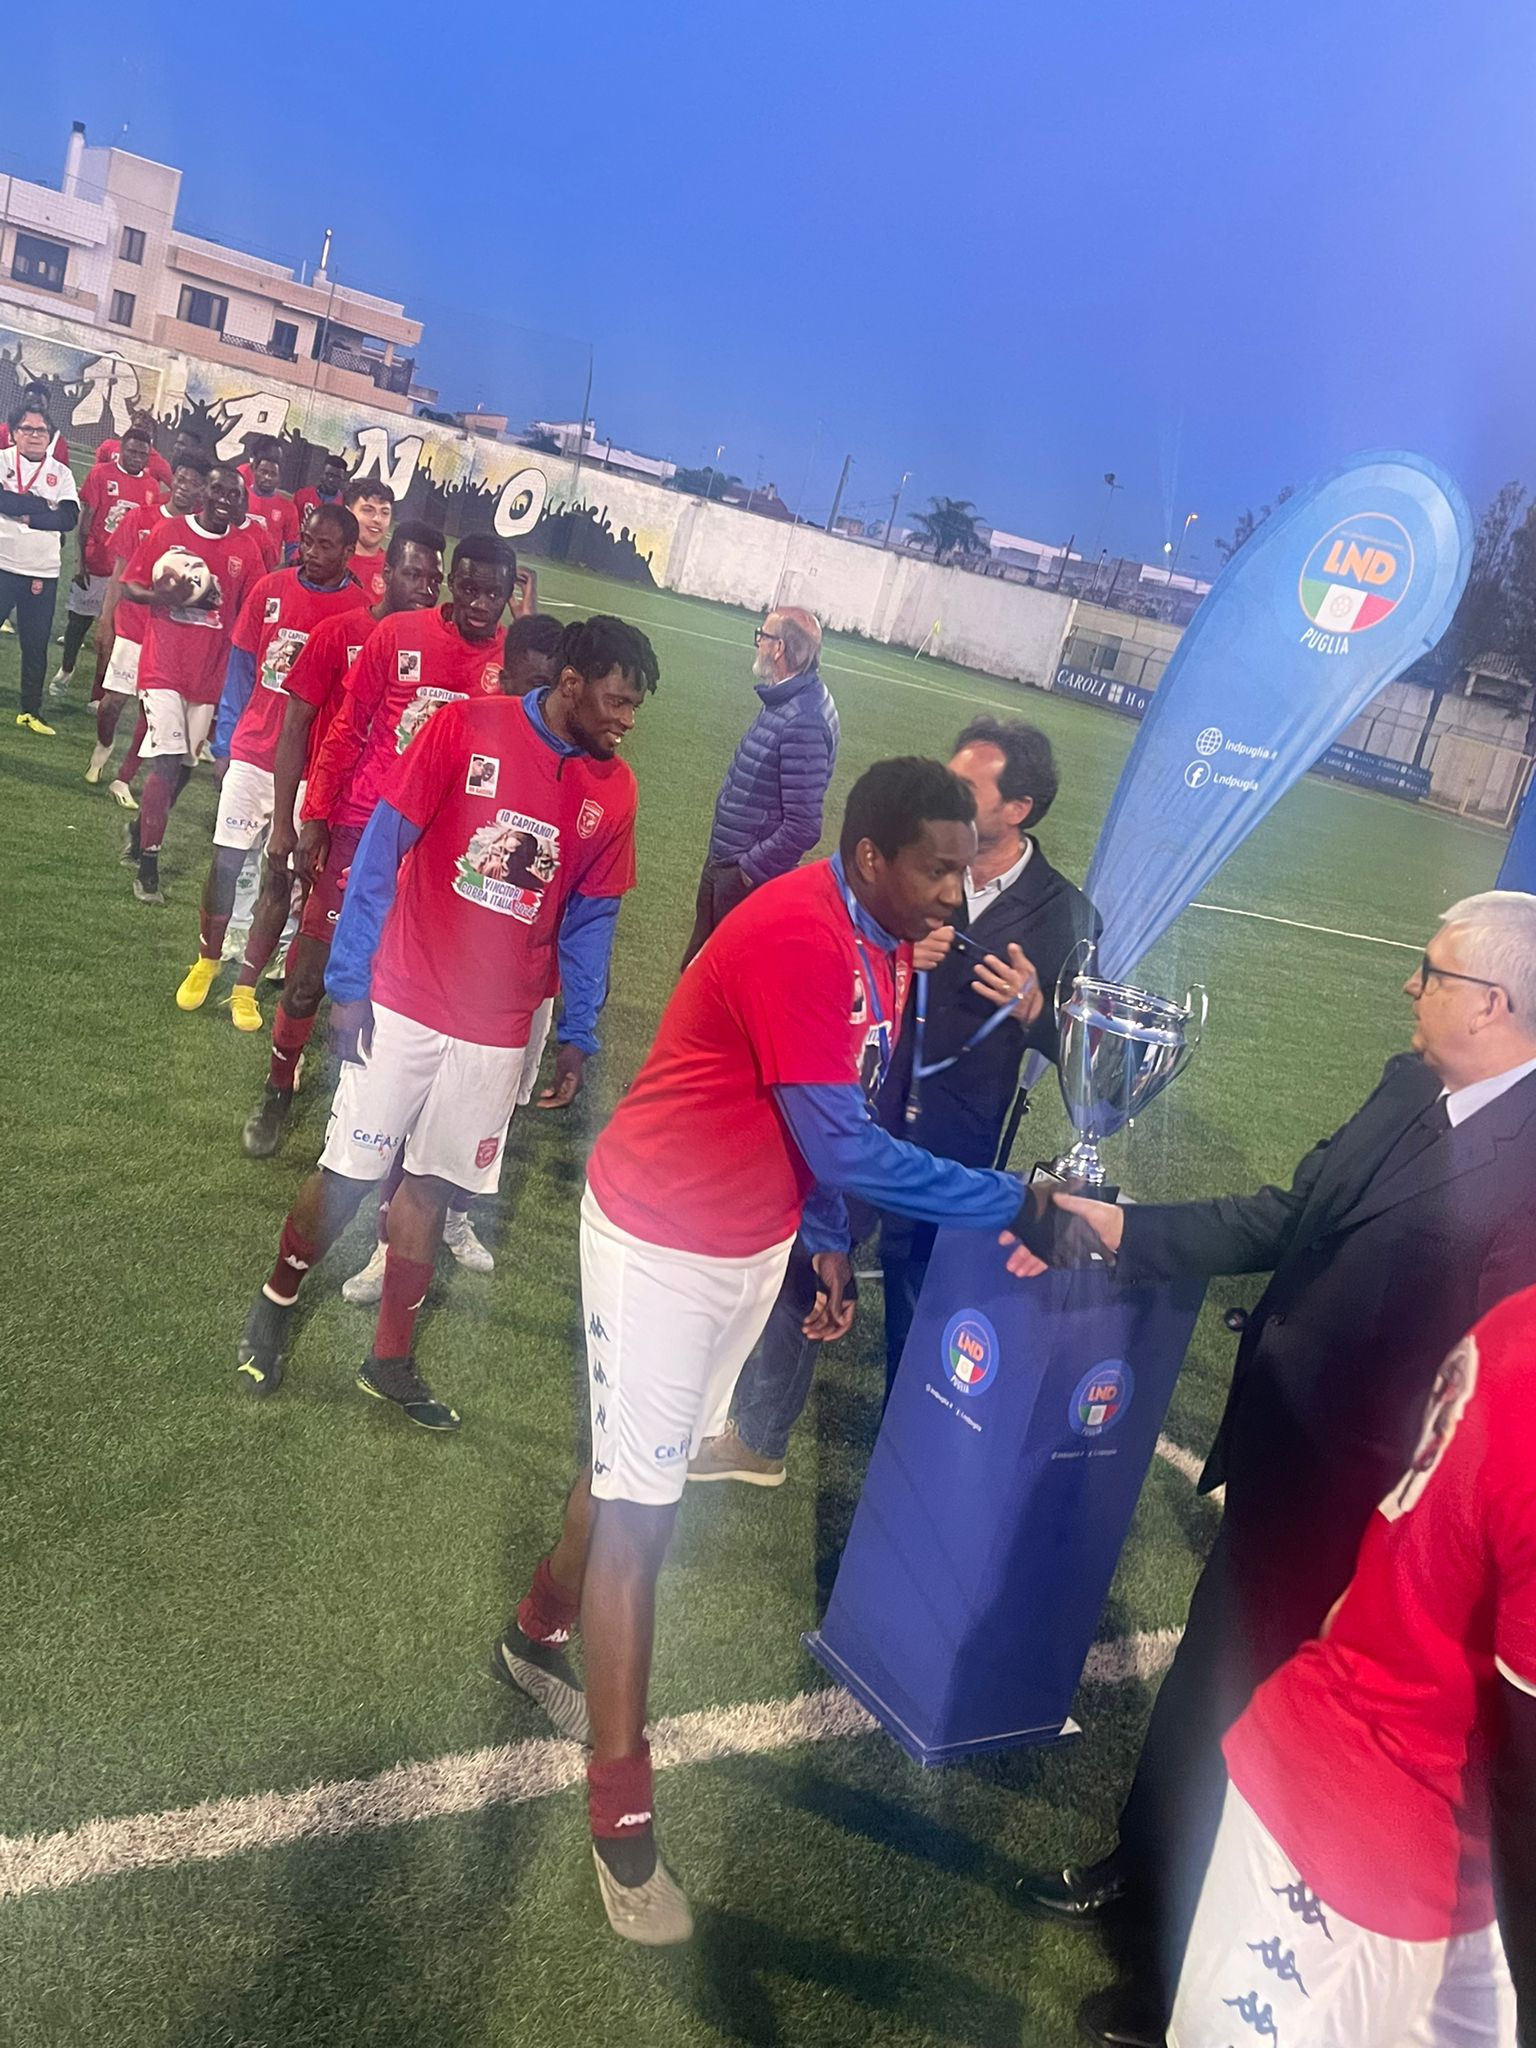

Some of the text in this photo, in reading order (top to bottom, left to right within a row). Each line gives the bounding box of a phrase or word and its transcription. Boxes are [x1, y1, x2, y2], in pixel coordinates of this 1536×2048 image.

[1323, 540, 1397, 586] LND
[1299, 627, 1349, 655] PUGLIA
[1057, 669, 1106, 697] CAROLI
[500, 811, 556, 840] IO CAPITANO!
[957, 1330, 984, 1362] LND
[1087, 1385, 1118, 1403] LND
